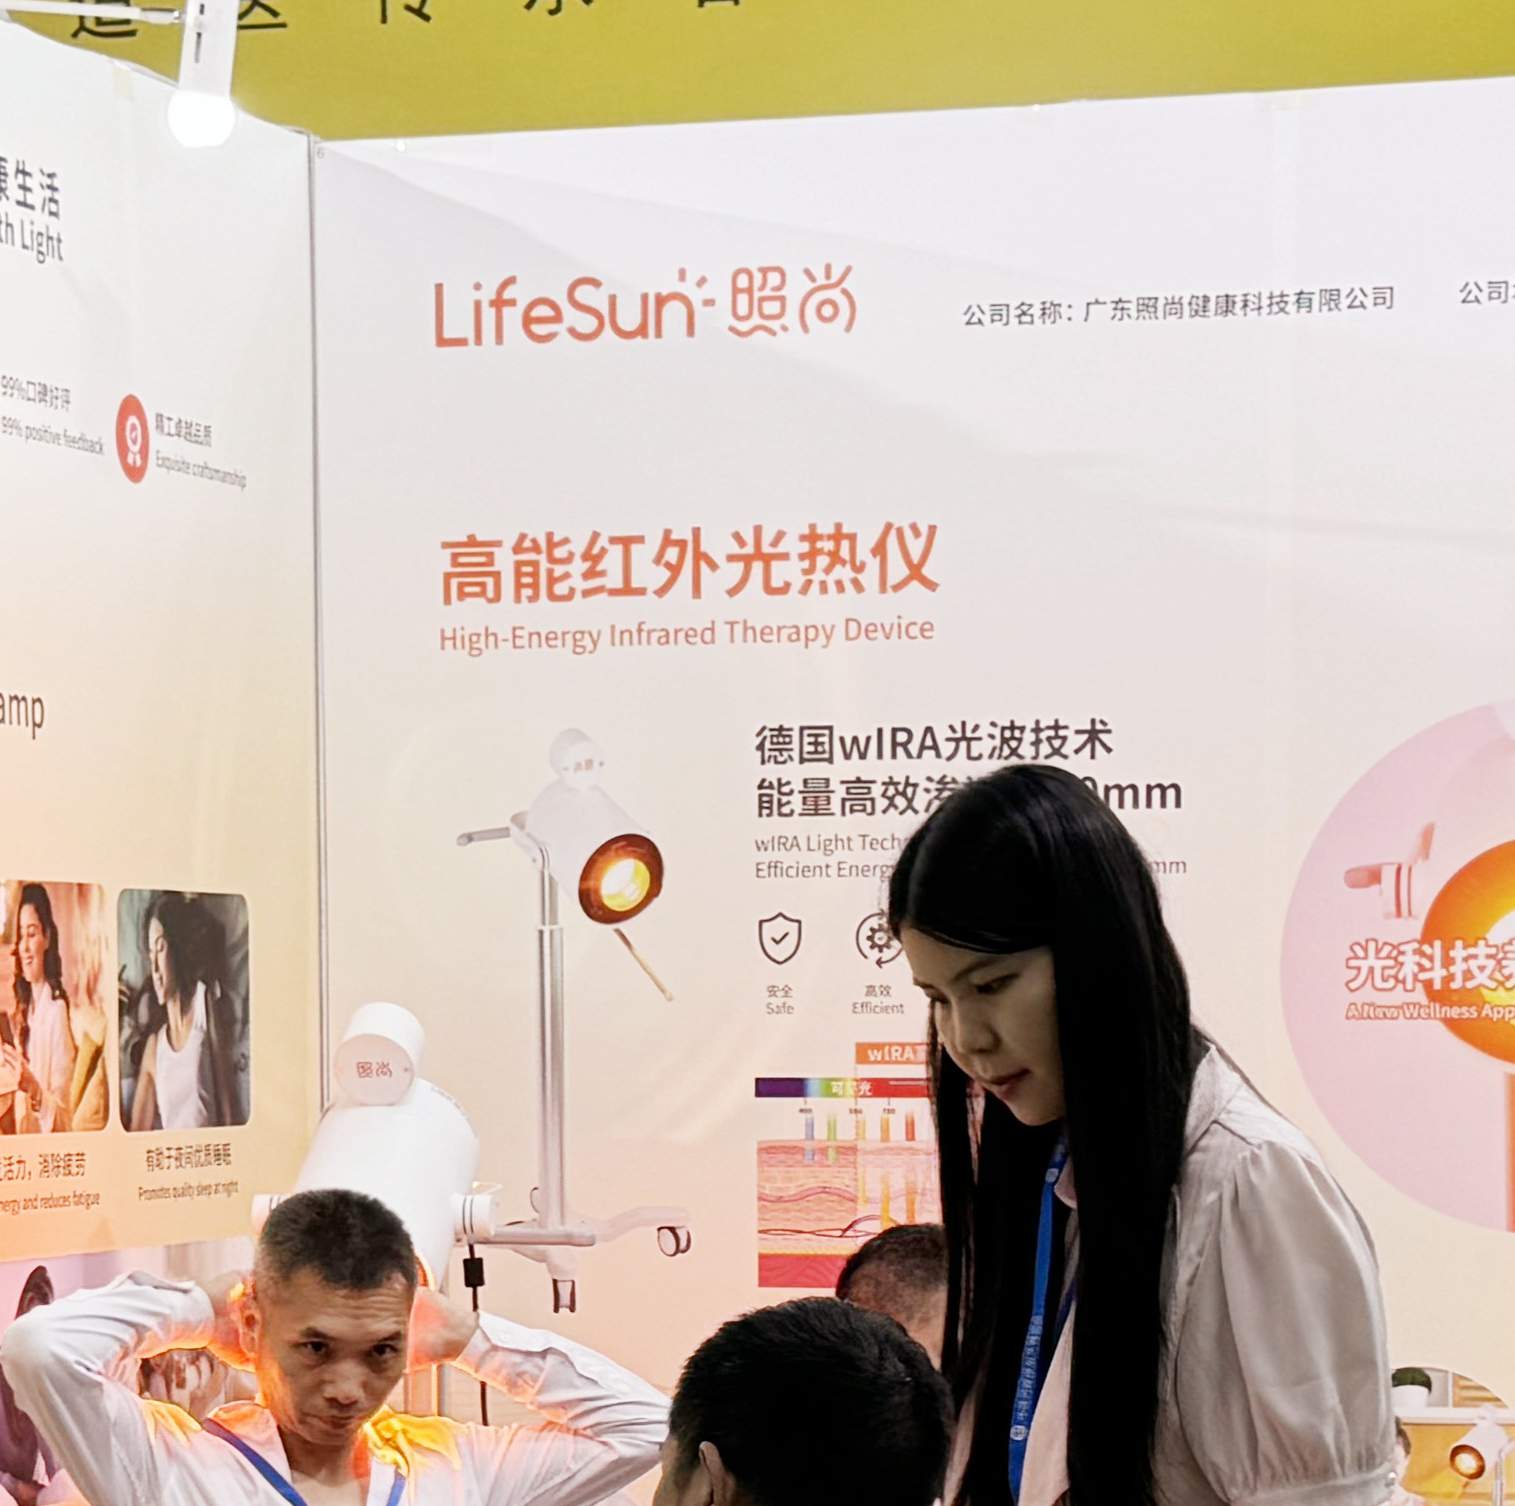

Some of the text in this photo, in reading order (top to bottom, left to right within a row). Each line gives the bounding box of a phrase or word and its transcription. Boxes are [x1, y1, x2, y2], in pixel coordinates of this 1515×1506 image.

[21, 219, 63, 264] Light
[434, 275, 696, 349] LifeSun
[727, 263, 857, 339] 照尚
[25, 423, 62, 446] positive
[63, 429, 104, 455] feedback
[440, 521, 940, 607] 高能红外光热仪
[440, 613, 935, 657] High-Energy Infrared Therapy Device
[755, 718, 1114, 765] 德国wIRA光波技术
[756, 775, 975, 818] 能量高效渗
[755, 834, 910, 857] wIRA Light Tech
[755, 860, 831, 879] Efficient
[766, 984, 794, 999] 安全
[865, 984, 892, 998] 高效
[766, 1002, 795, 1015] Safe
[852, 1001, 905, 1015] Efficient
[1403, 1002, 1478, 1019] Wellness
[22, 1195, 38, 1211] and
[40, 1193, 71, 1209] reduces
